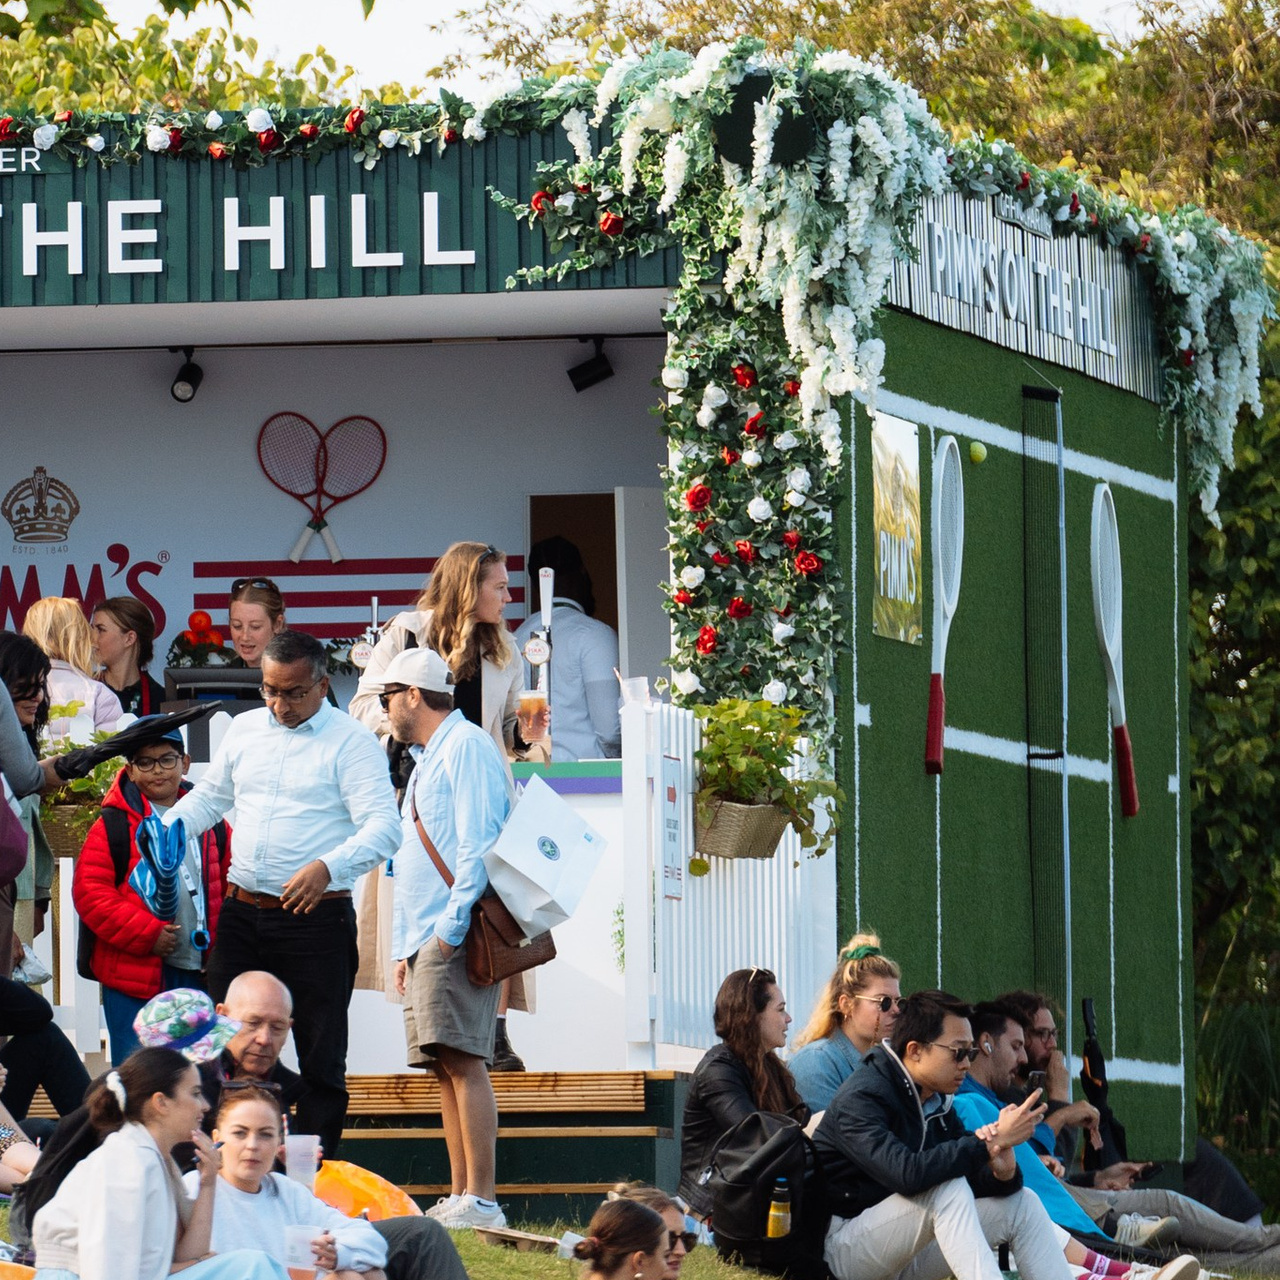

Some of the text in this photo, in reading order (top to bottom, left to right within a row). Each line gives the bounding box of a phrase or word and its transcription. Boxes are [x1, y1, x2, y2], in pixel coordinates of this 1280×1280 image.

[223, 191, 476, 270] HILL
[928, 221, 1117, 357] PIMM'S ON THE HILL
[45, 544, 69, 555] 1840
[880, 522, 917, 605] PIMM'S
